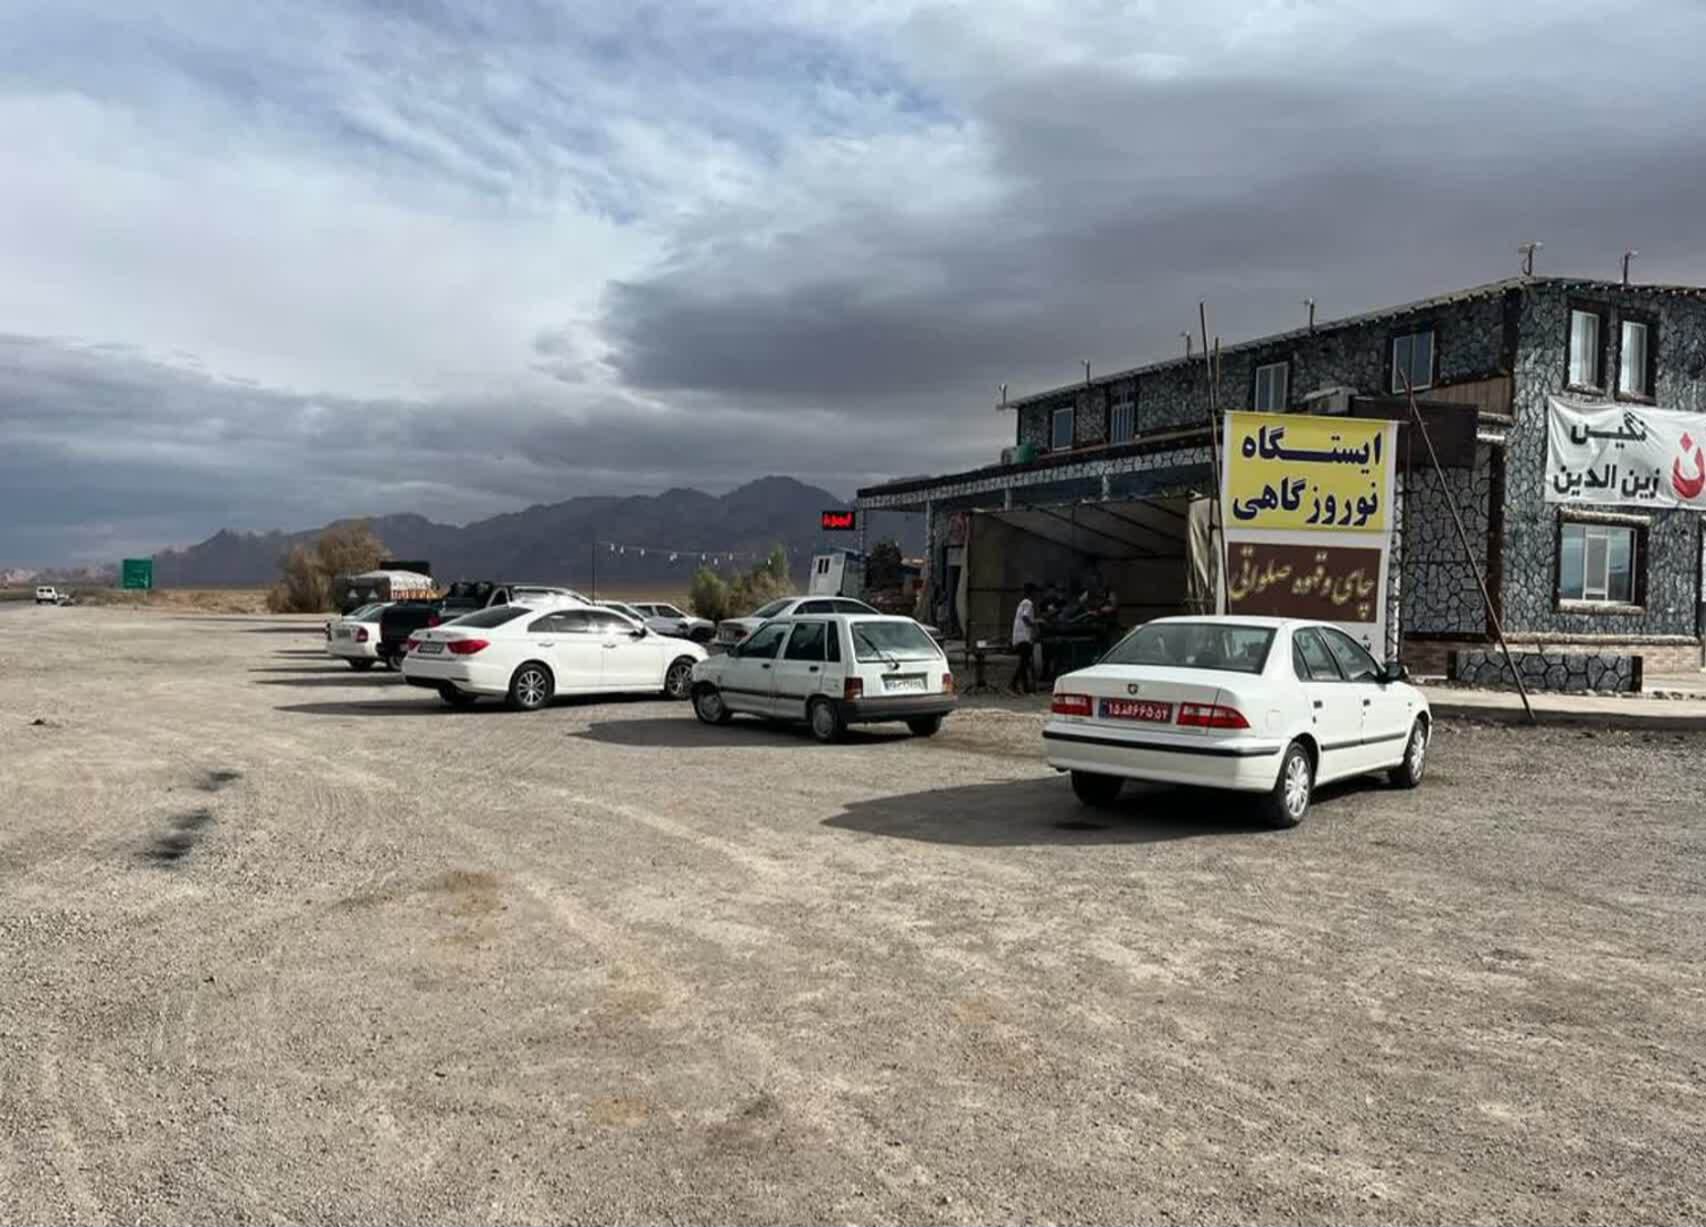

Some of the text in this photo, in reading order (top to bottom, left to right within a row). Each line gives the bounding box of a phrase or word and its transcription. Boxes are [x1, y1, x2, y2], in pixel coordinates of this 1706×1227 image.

[1241, 425, 1382, 474] ایستگاه
[1553, 463, 1661, 499] زین الدین
[1319, 575, 1332, 597] و
